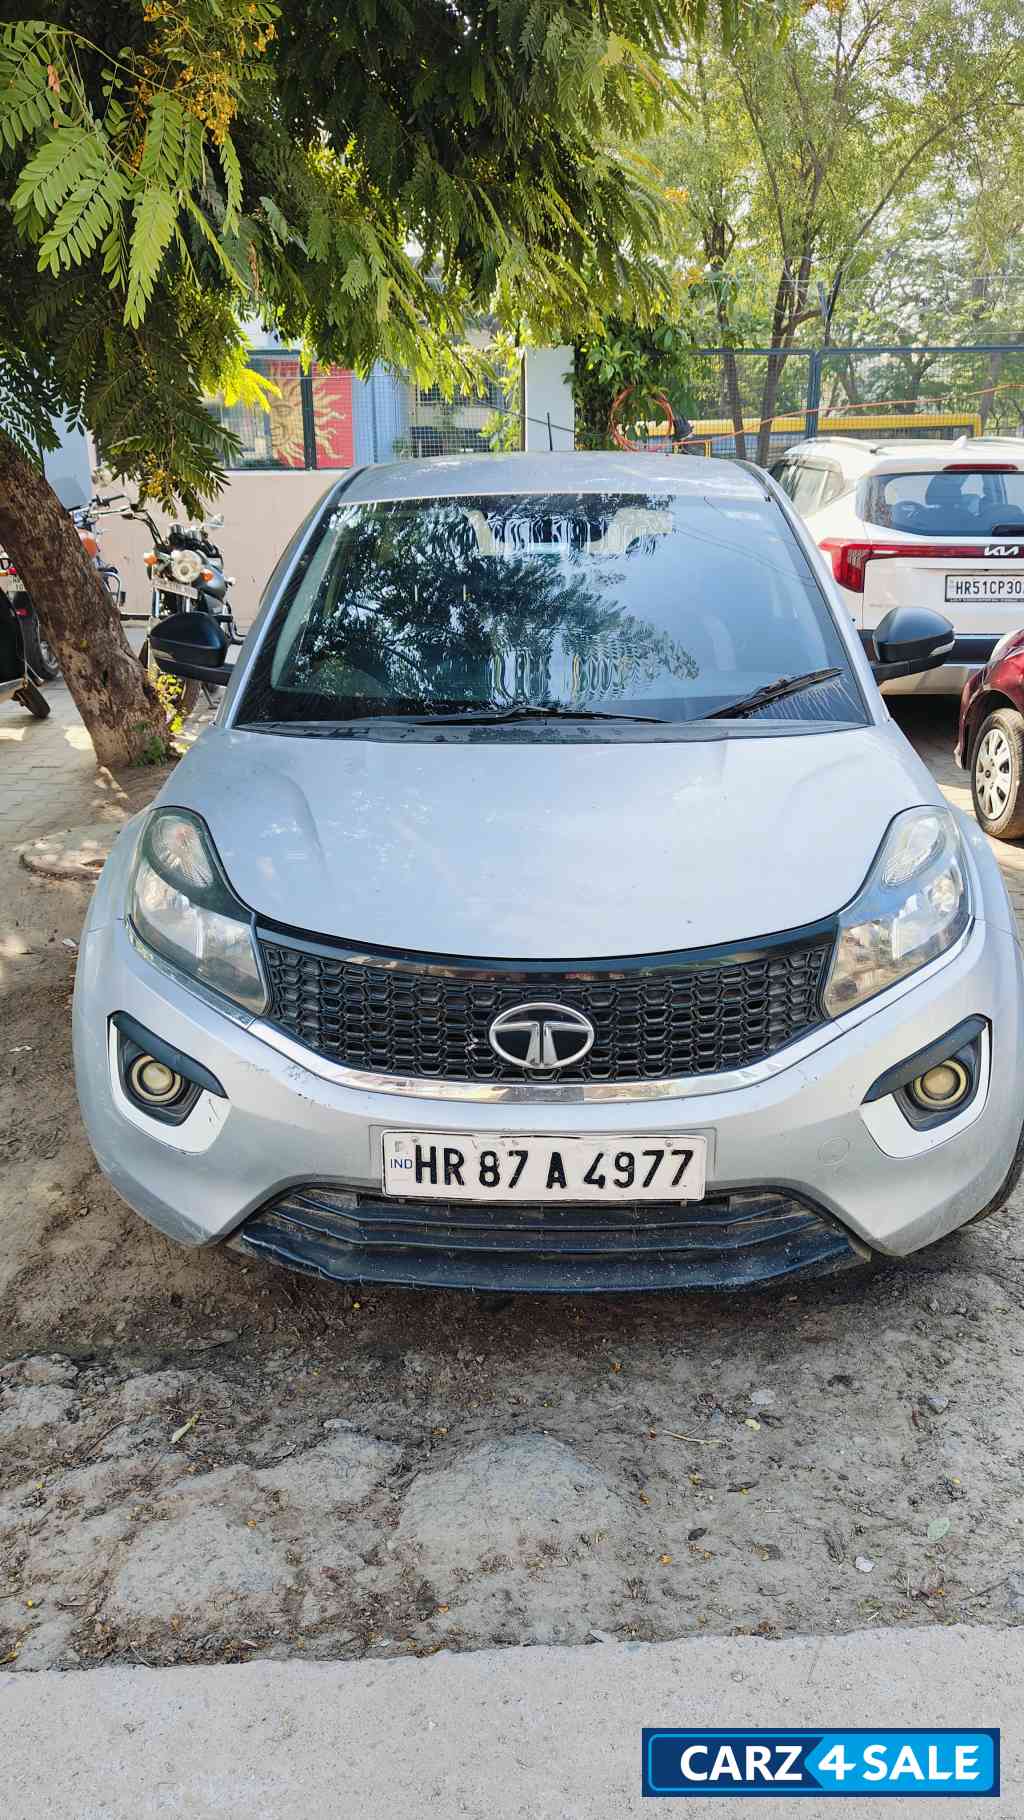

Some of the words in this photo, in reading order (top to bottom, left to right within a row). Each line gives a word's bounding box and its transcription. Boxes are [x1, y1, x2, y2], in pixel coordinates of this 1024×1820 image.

[984, 546, 1019, 556] KIA
[956, 581, 1024, 594] HR51CP30
[390, 1158, 413, 1169] IND
[415, 1145, 465, 1186] HR
[478, 1150, 529, 1188] 87
[545, 1151, 567, 1189] A
[583, 1150, 694, 1189] 4977
